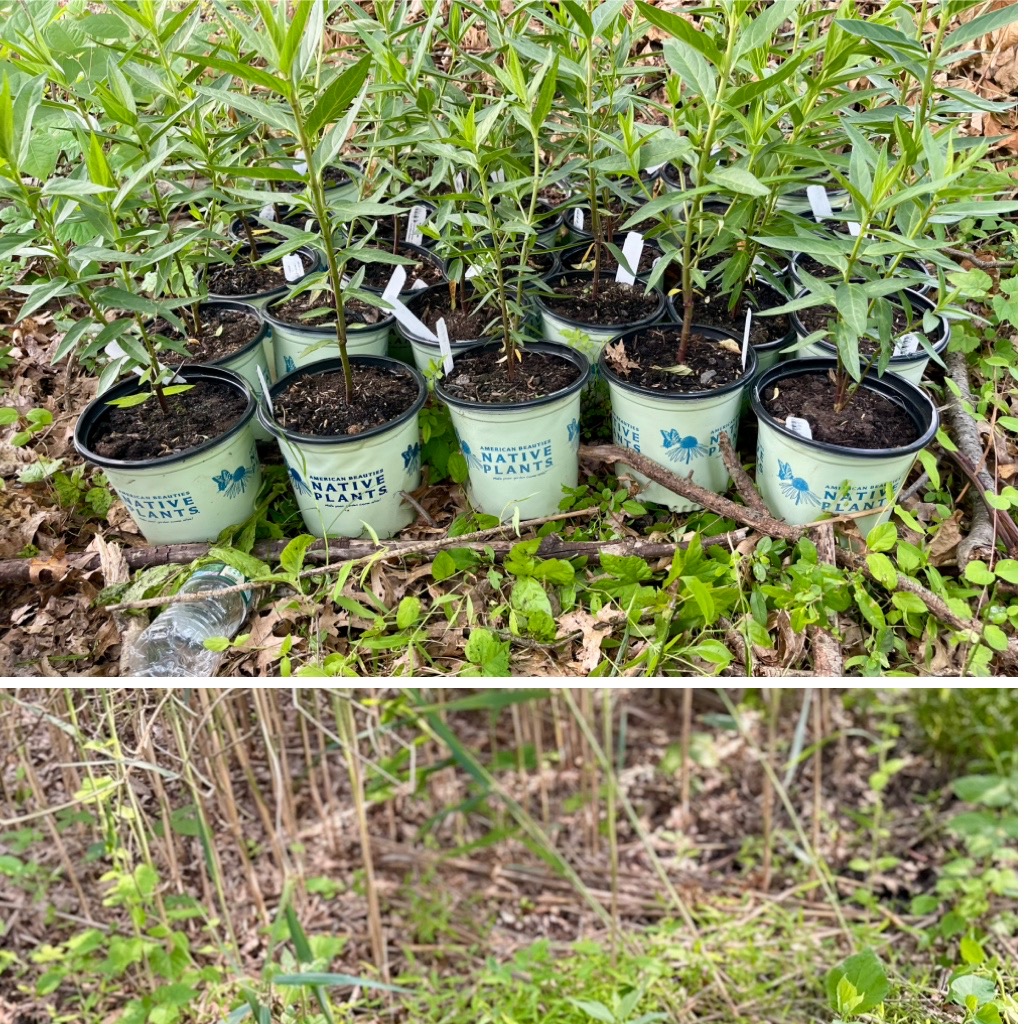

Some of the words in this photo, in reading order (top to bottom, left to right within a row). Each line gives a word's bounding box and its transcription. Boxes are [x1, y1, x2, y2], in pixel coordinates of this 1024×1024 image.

[518, 439, 552, 451] BEAUTIES
[482, 445, 552, 463] NATIVE
[348, 468, 384, 480] BEAUTIES
[312, 474, 385, 493] NATIVE
[152, 490, 190, 501] BEAUTIES
[122, 496, 194, 510] NATIVE
